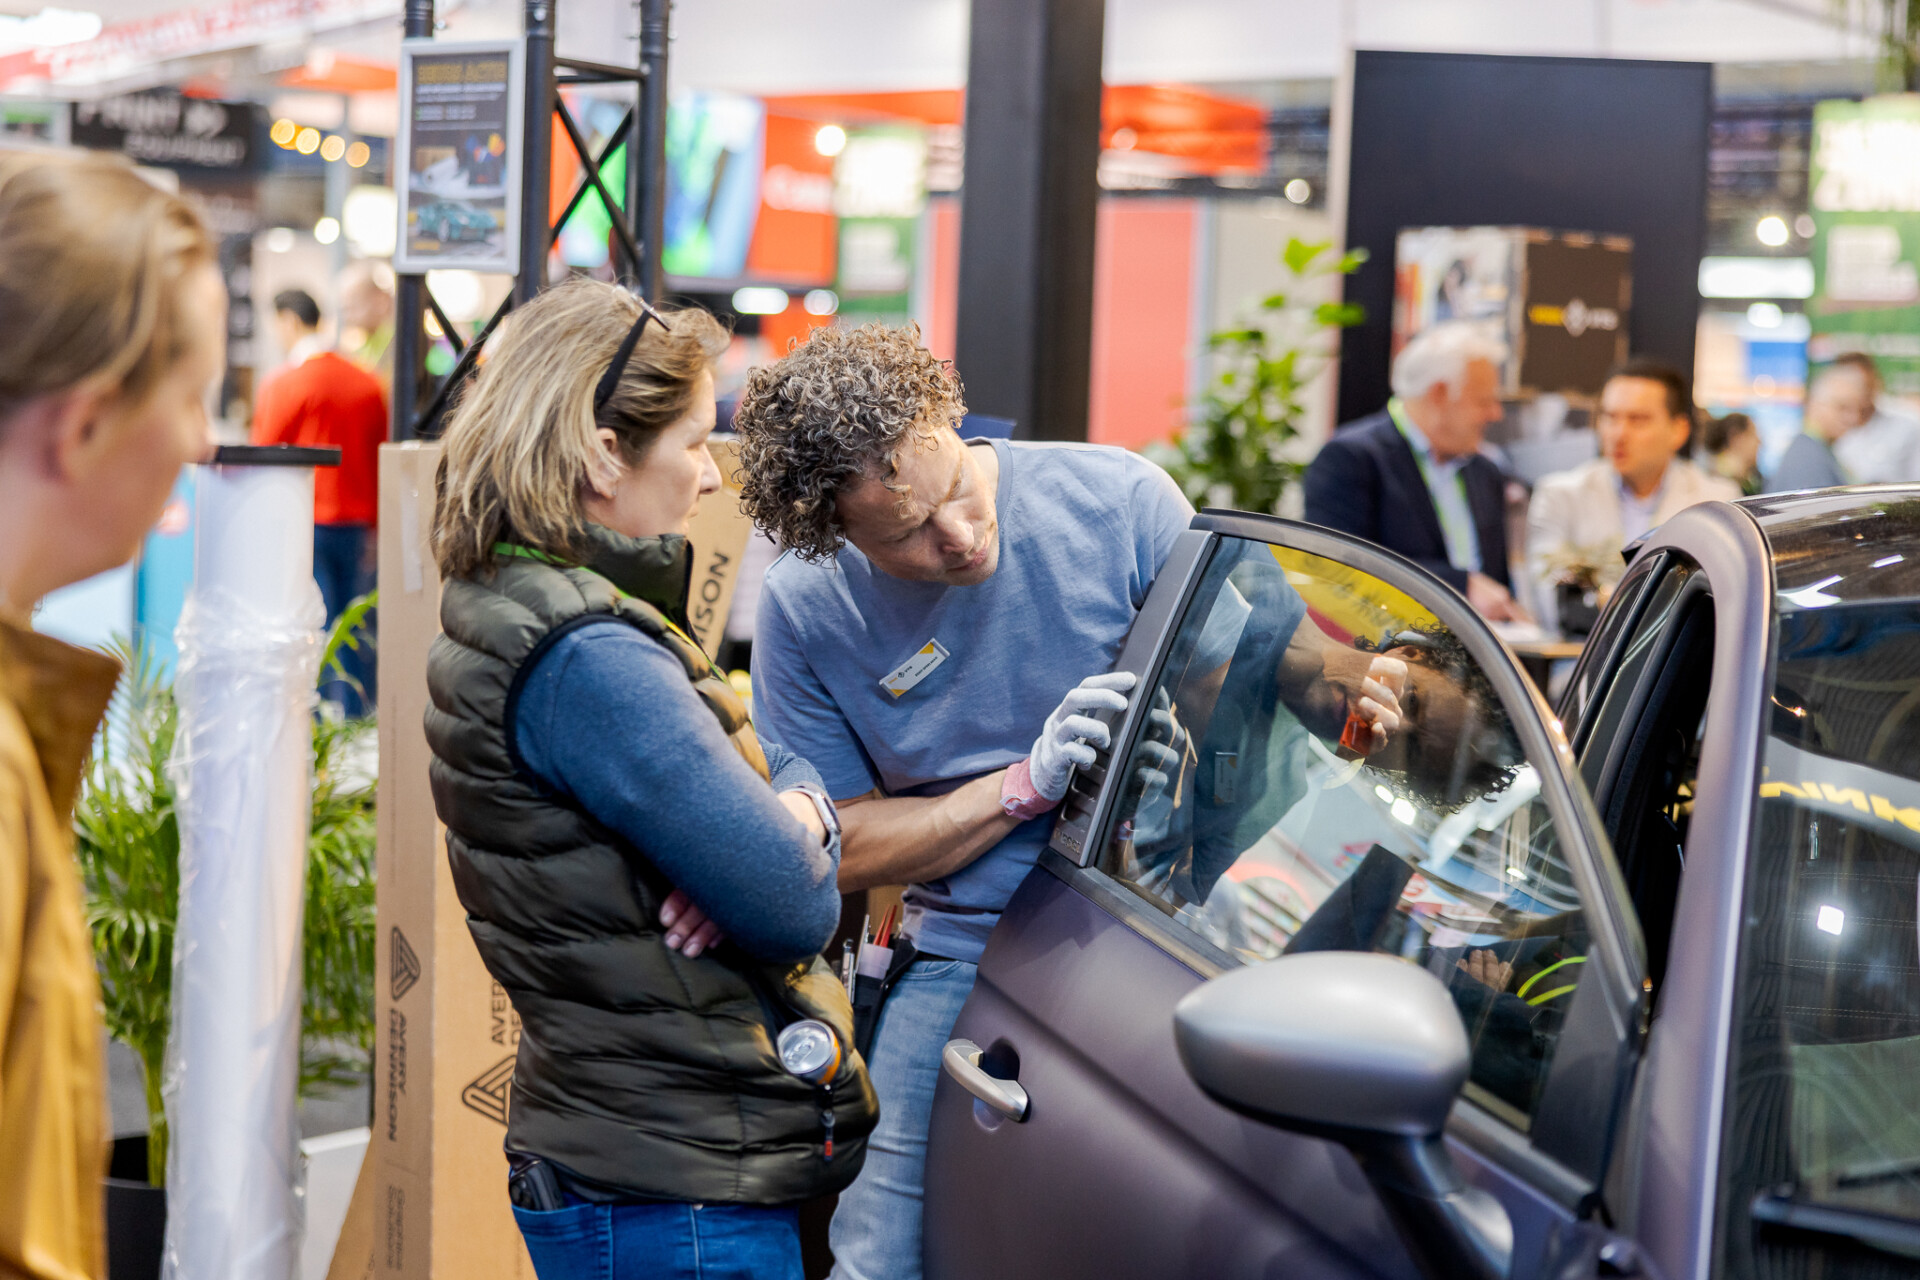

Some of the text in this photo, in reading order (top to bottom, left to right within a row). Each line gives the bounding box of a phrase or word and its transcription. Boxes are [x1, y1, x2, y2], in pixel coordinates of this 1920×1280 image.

[693, 550, 729, 645] ISON
[399, 1011, 407, 1096] AVERY
[491, 976, 507, 1046] AVER
[388, 1007, 398, 1142] DENNISON
